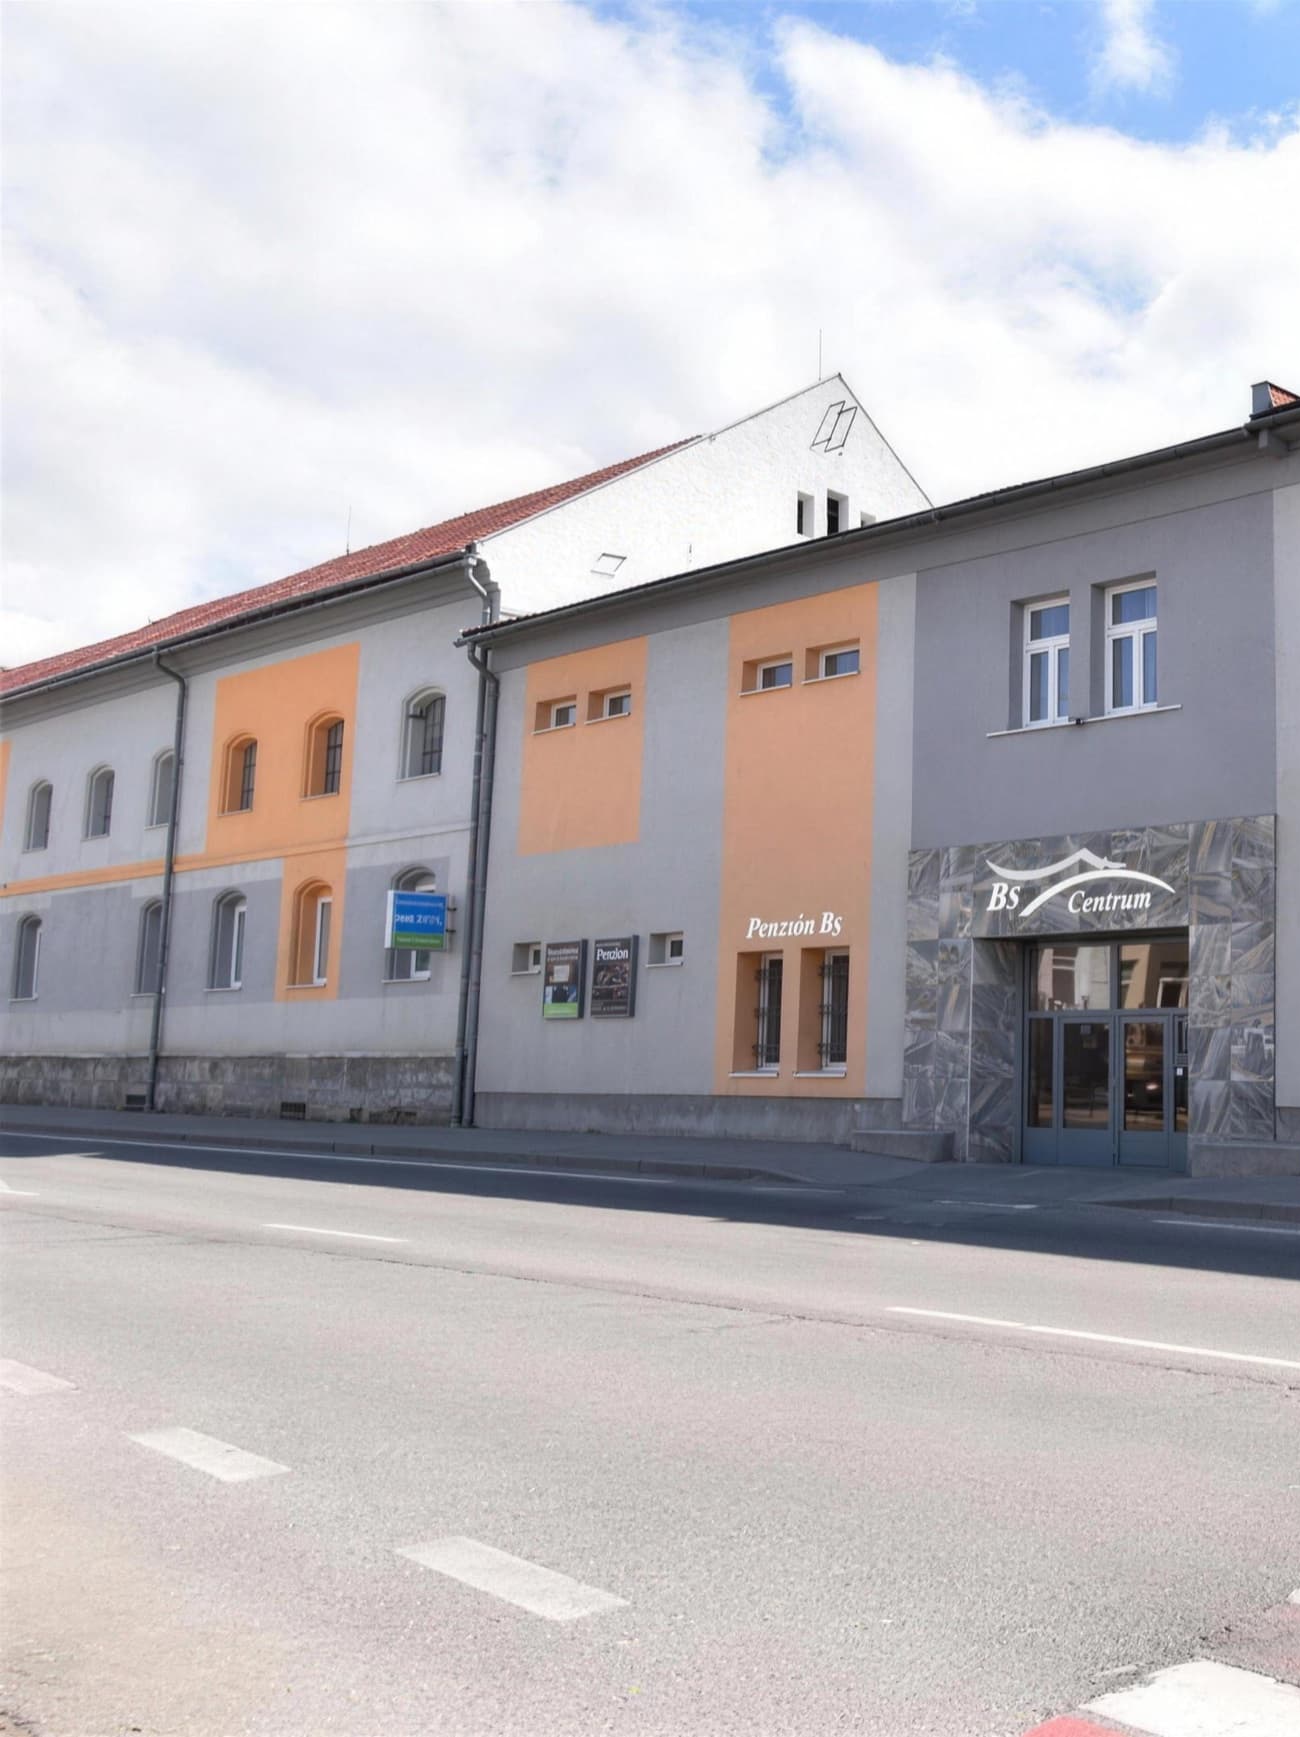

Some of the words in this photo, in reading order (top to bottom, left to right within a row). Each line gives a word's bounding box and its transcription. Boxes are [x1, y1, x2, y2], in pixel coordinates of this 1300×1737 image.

[986, 882, 1021, 912] Bs
[1067, 890, 1152, 913] Centrum
[745, 913, 816, 939] Penzión
[819, 911, 843, 937] Bs
